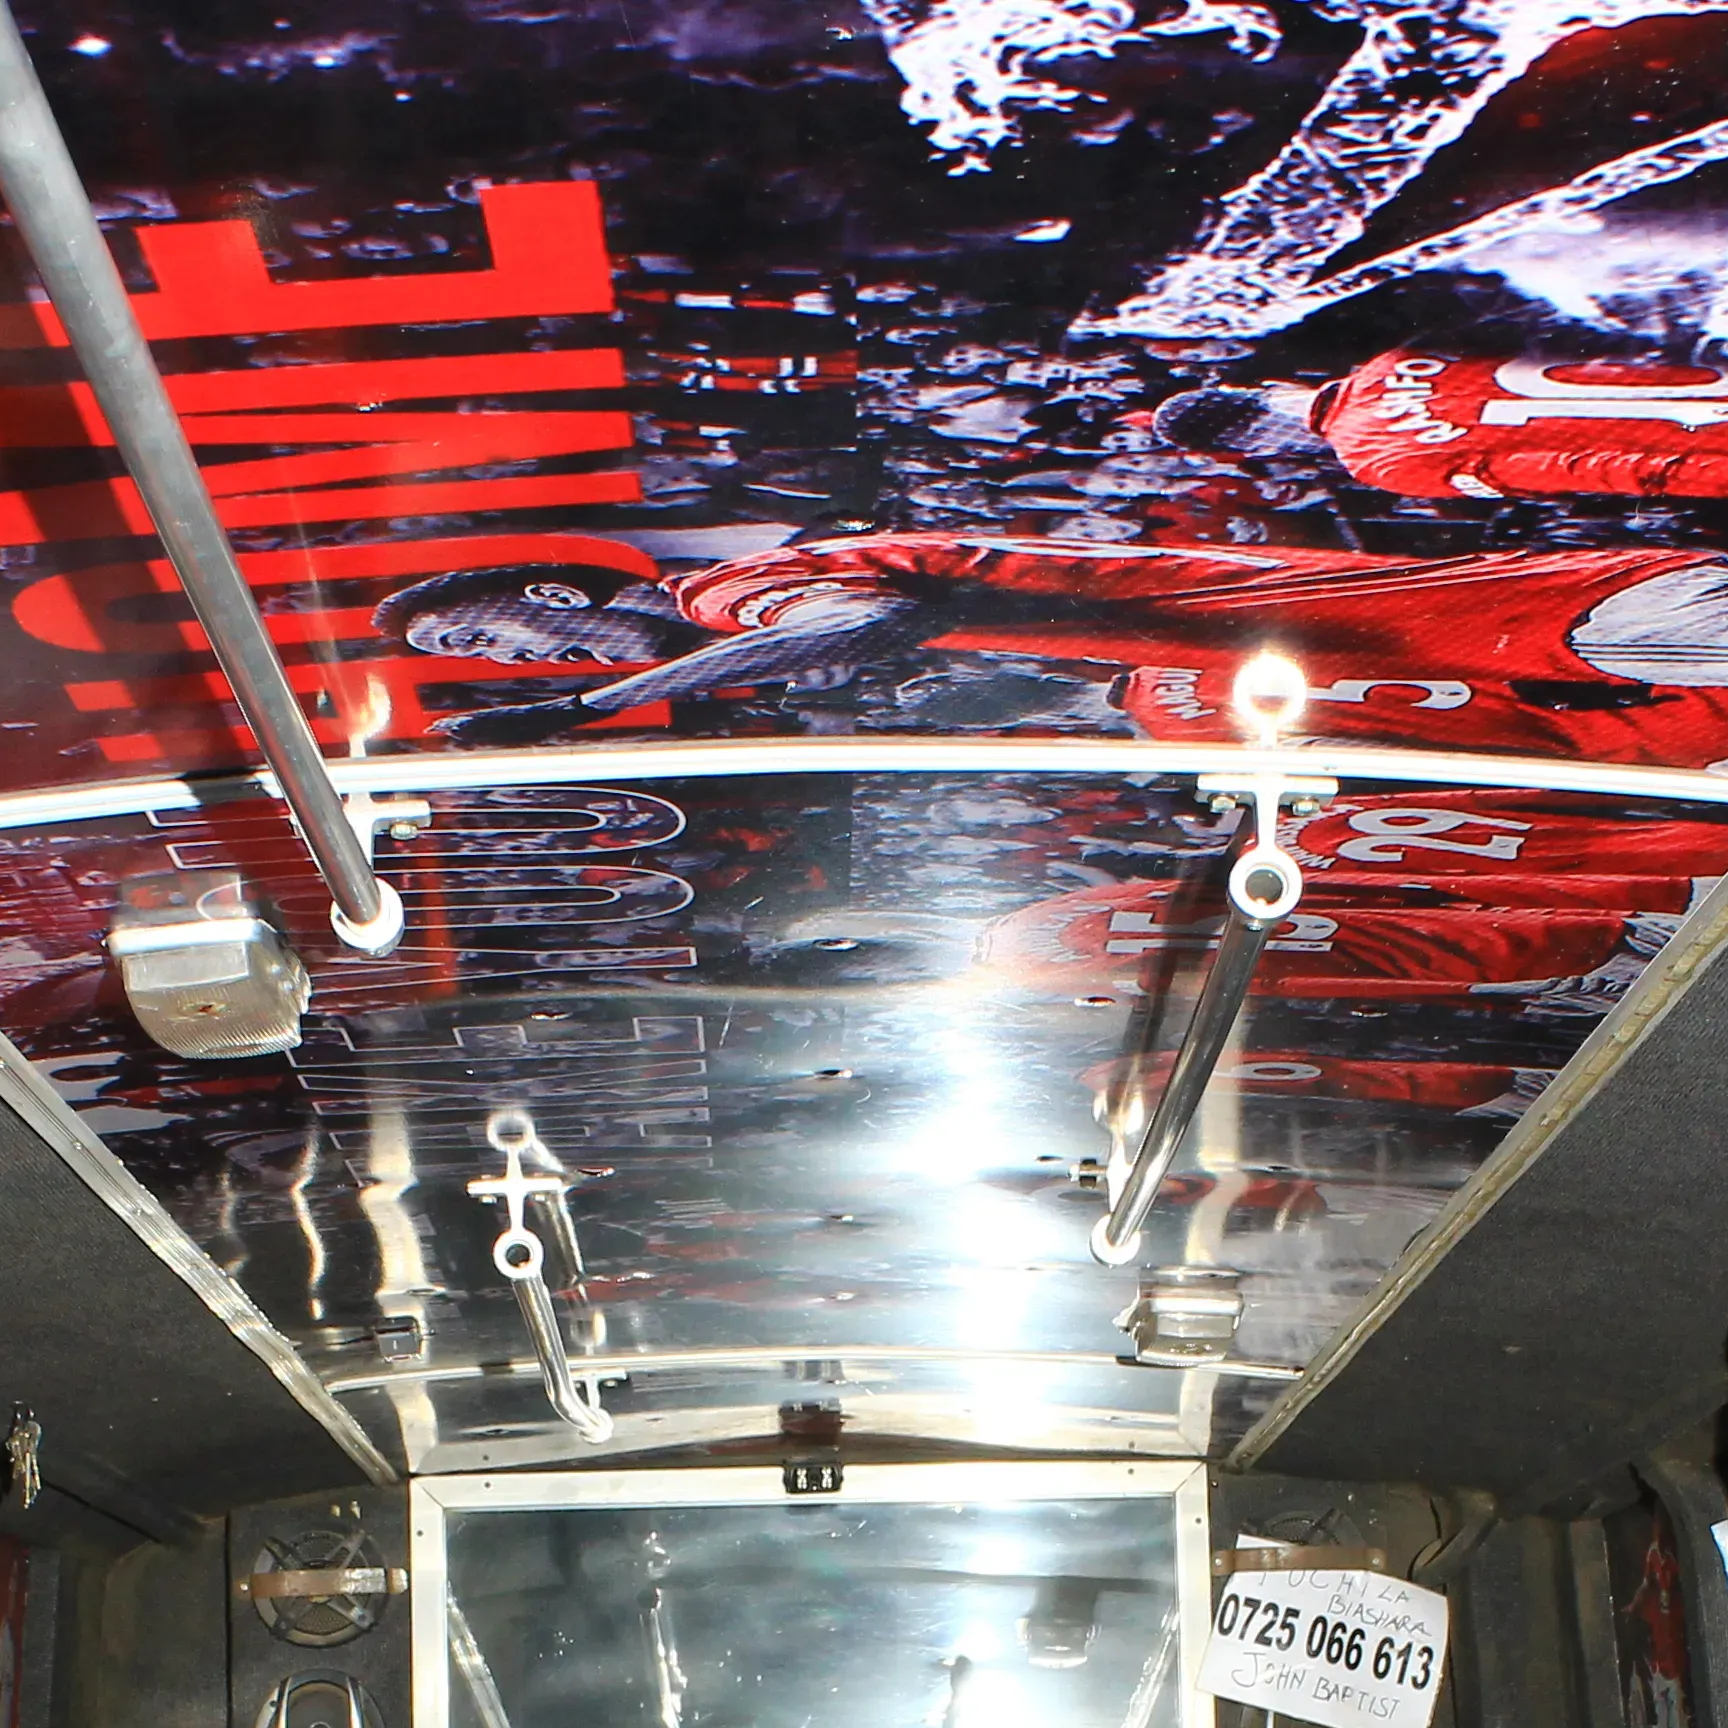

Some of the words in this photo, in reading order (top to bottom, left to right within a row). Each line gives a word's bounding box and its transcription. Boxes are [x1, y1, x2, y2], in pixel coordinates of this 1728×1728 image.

[1334, 807, 1534, 863] 29
[1326, 1593, 1433, 1638] BIASHARA
[1217, 1592, 1302, 1652] 0725
[1305, 1615, 1367, 1671] 066
[1372, 1636, 1435, 1691] 613
[1312, 1676, 1402, 1721] BAPTIST
